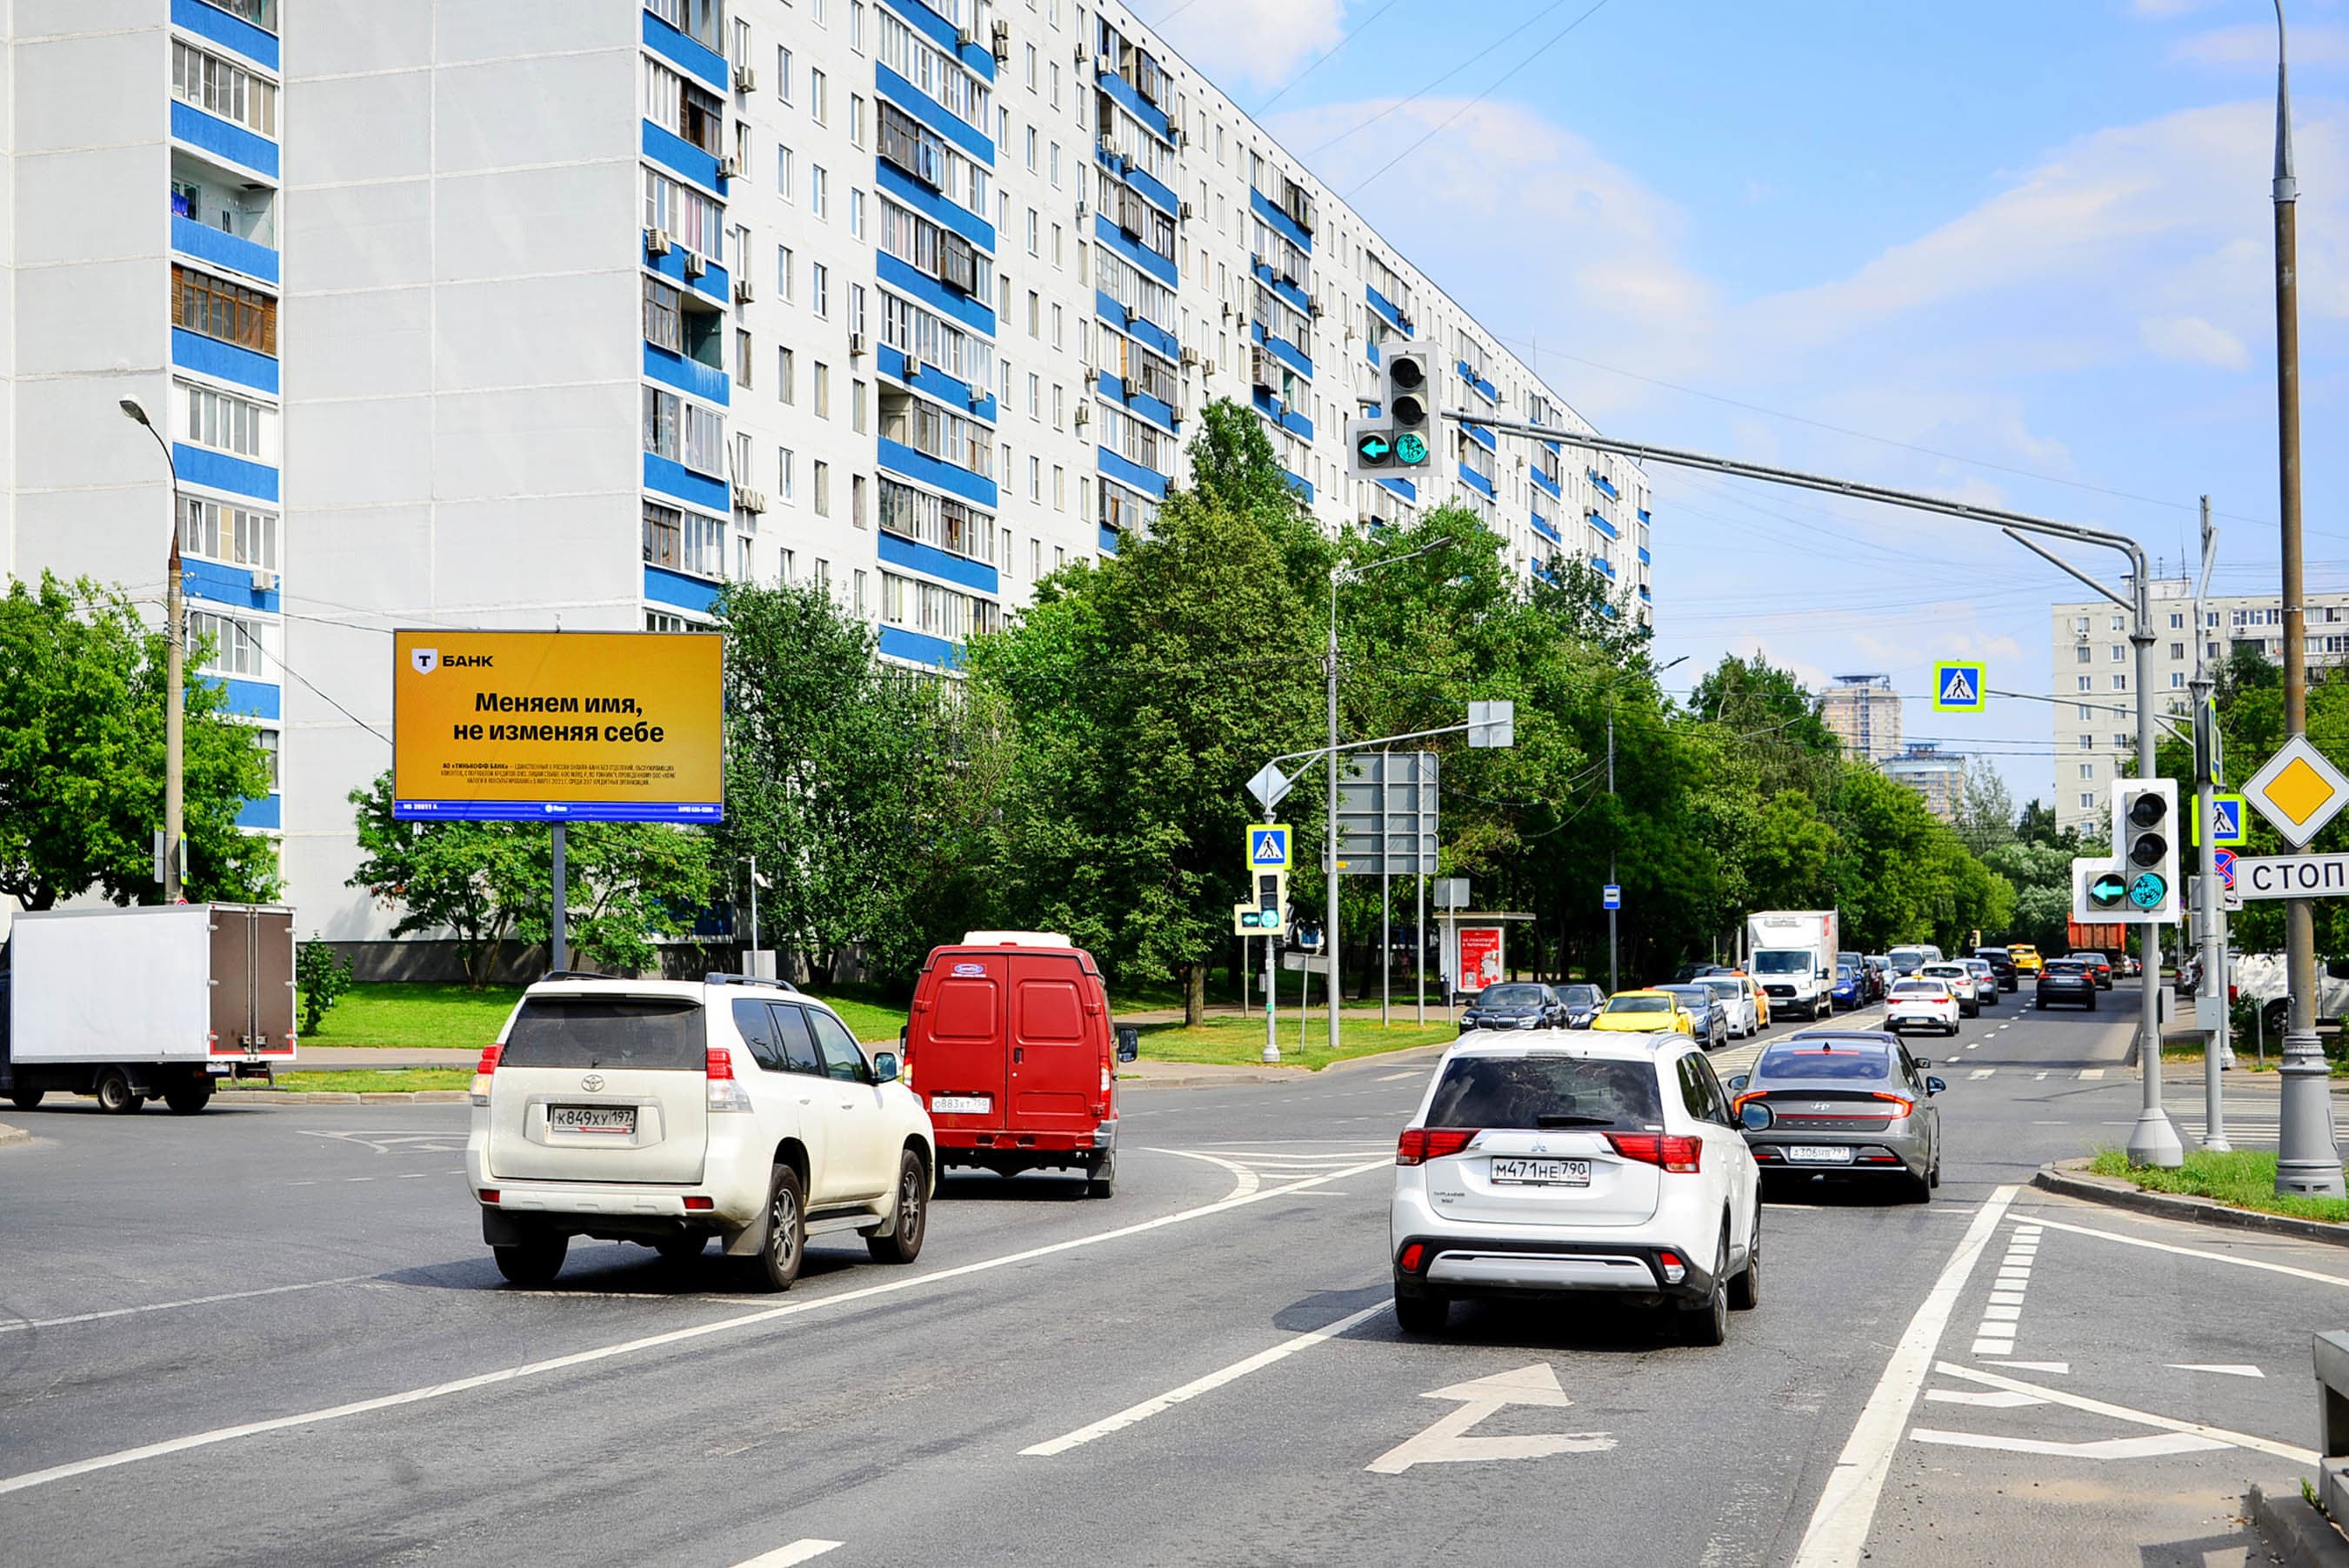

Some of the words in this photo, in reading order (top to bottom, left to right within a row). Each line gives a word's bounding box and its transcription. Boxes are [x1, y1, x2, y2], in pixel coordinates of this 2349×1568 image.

[442, 655, 494, 667] БАНК
[475, 692, 578, 713] Меняем
[584, 697, 643, 717] имя,
[453, 724, 484, 740] не
[489, 724, 598, 742] изменяя
[604, 720, 664, 743] себе
[2252, 862, 2344, 891] СТОП
